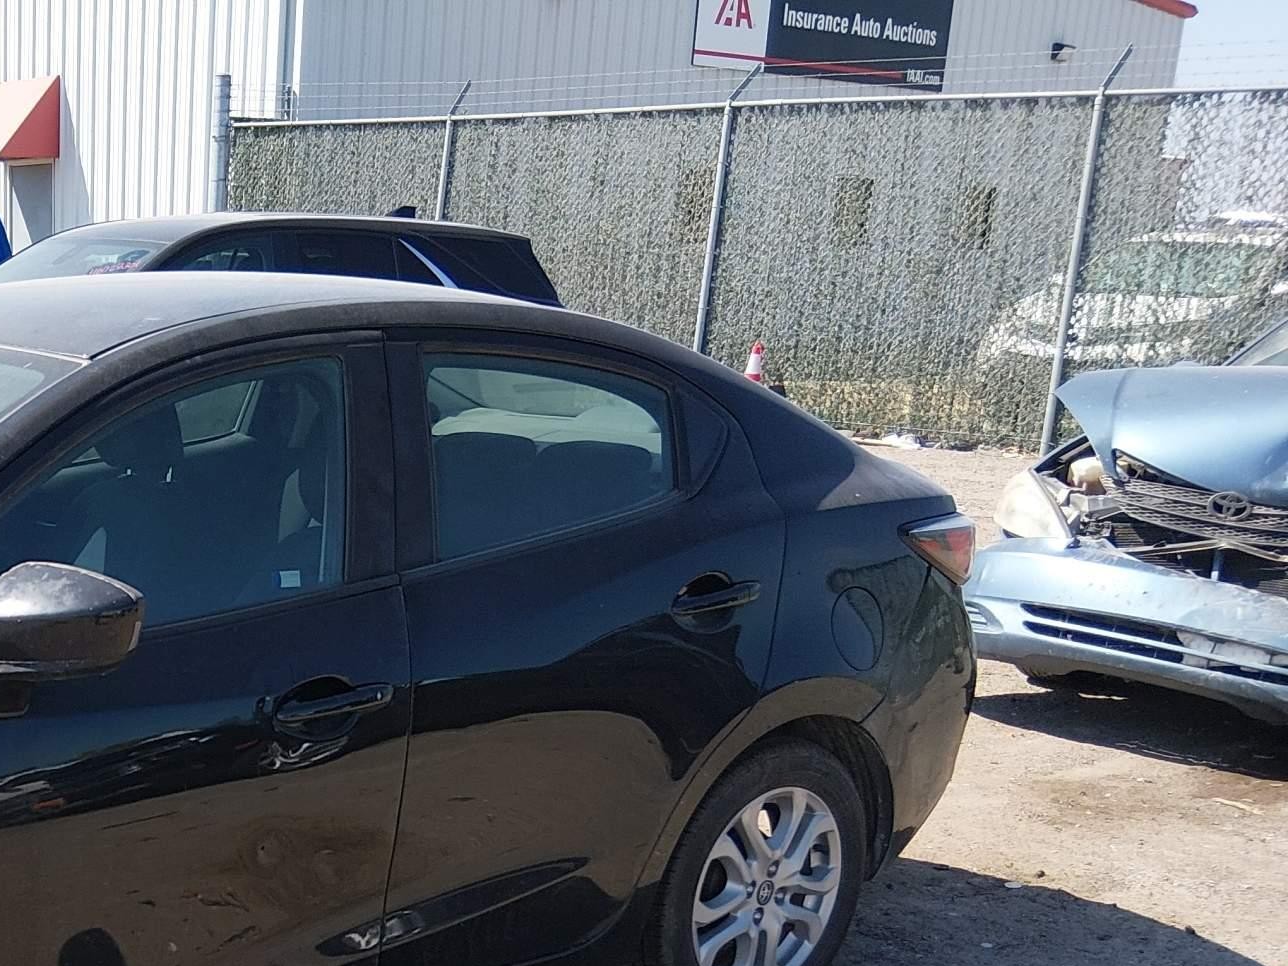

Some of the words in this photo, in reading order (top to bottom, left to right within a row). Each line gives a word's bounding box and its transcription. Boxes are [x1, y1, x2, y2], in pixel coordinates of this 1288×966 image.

[783, 2, 849, 34] Insurance
[851, 13, 881, 39] Auto
[883, 18, 937, 47] Auctions
